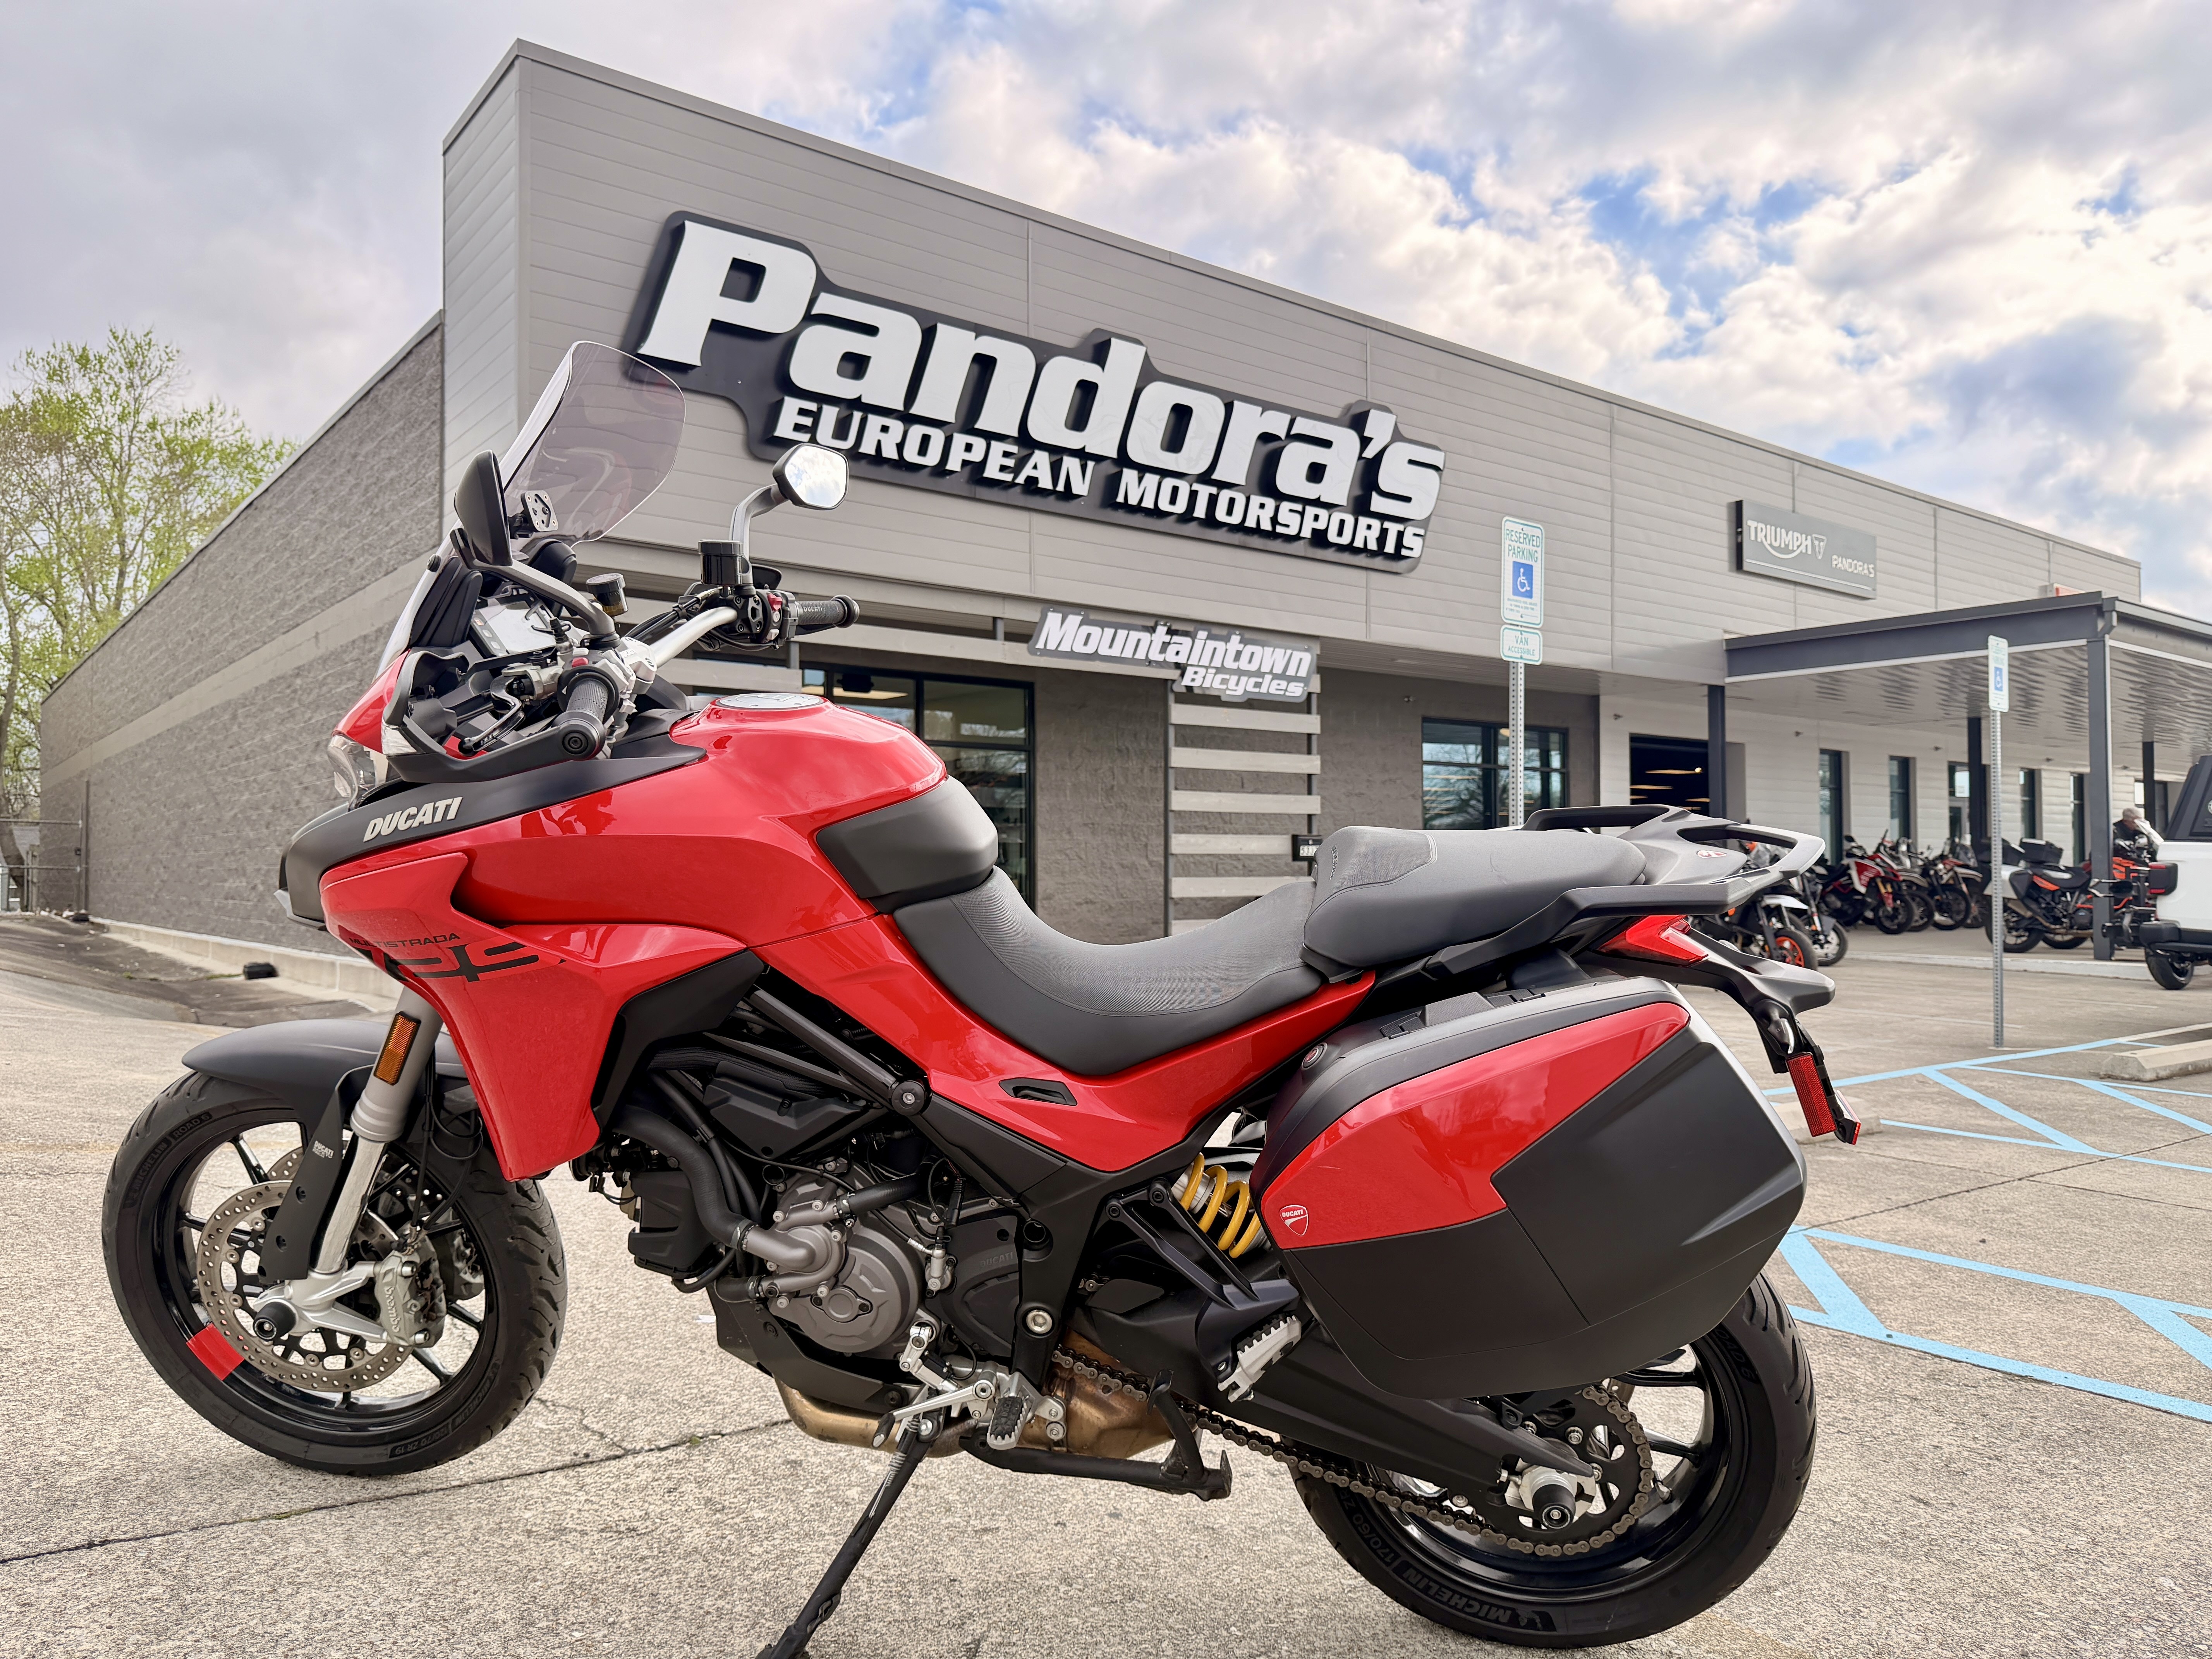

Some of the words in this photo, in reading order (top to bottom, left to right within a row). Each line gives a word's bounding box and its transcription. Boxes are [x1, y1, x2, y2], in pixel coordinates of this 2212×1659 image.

[637, 220, 1446, 522] Pandora's
[774, 395, 1098, 497] EUROPEAN
[1116, 472, 1427, 560] MOTORSPORTS
[1505, 528, 1540, 548] RESERVED
[1747, 519, 1812, 559] TRIUMPH
[1508, 544, 1539, 563] PARKING
[1035, 611, 1312, 678] Mountaintown
[1507, 645, 1536, 657] ACCESSIBLE
[1515, 635, 1529, 647] VAN
[1181, 666, 1304, 696] Bicycles
[363, 796, 464, 842] DUCATI
[349, 932, 461, 948] MULTISTRADA
[173, 1118, 201, 1139] ROAD
[133, 1142, 168, 1191] MICHELIN
[1282, 1209, 1304, 1217] DUCATI
[979, 1251, 1014, 1267] DUCATI
[383, 1286, 402, 1333] brembo
[453, 1379, 491, 1427] MICHELIN
[395, 1446, 405, 1455] 19
[406, 1441, 419, 1451] ZR
[1352, 1512, 1394, 1563] 170/60
[1402, 1566, 1512, 1623] MICHELIN
